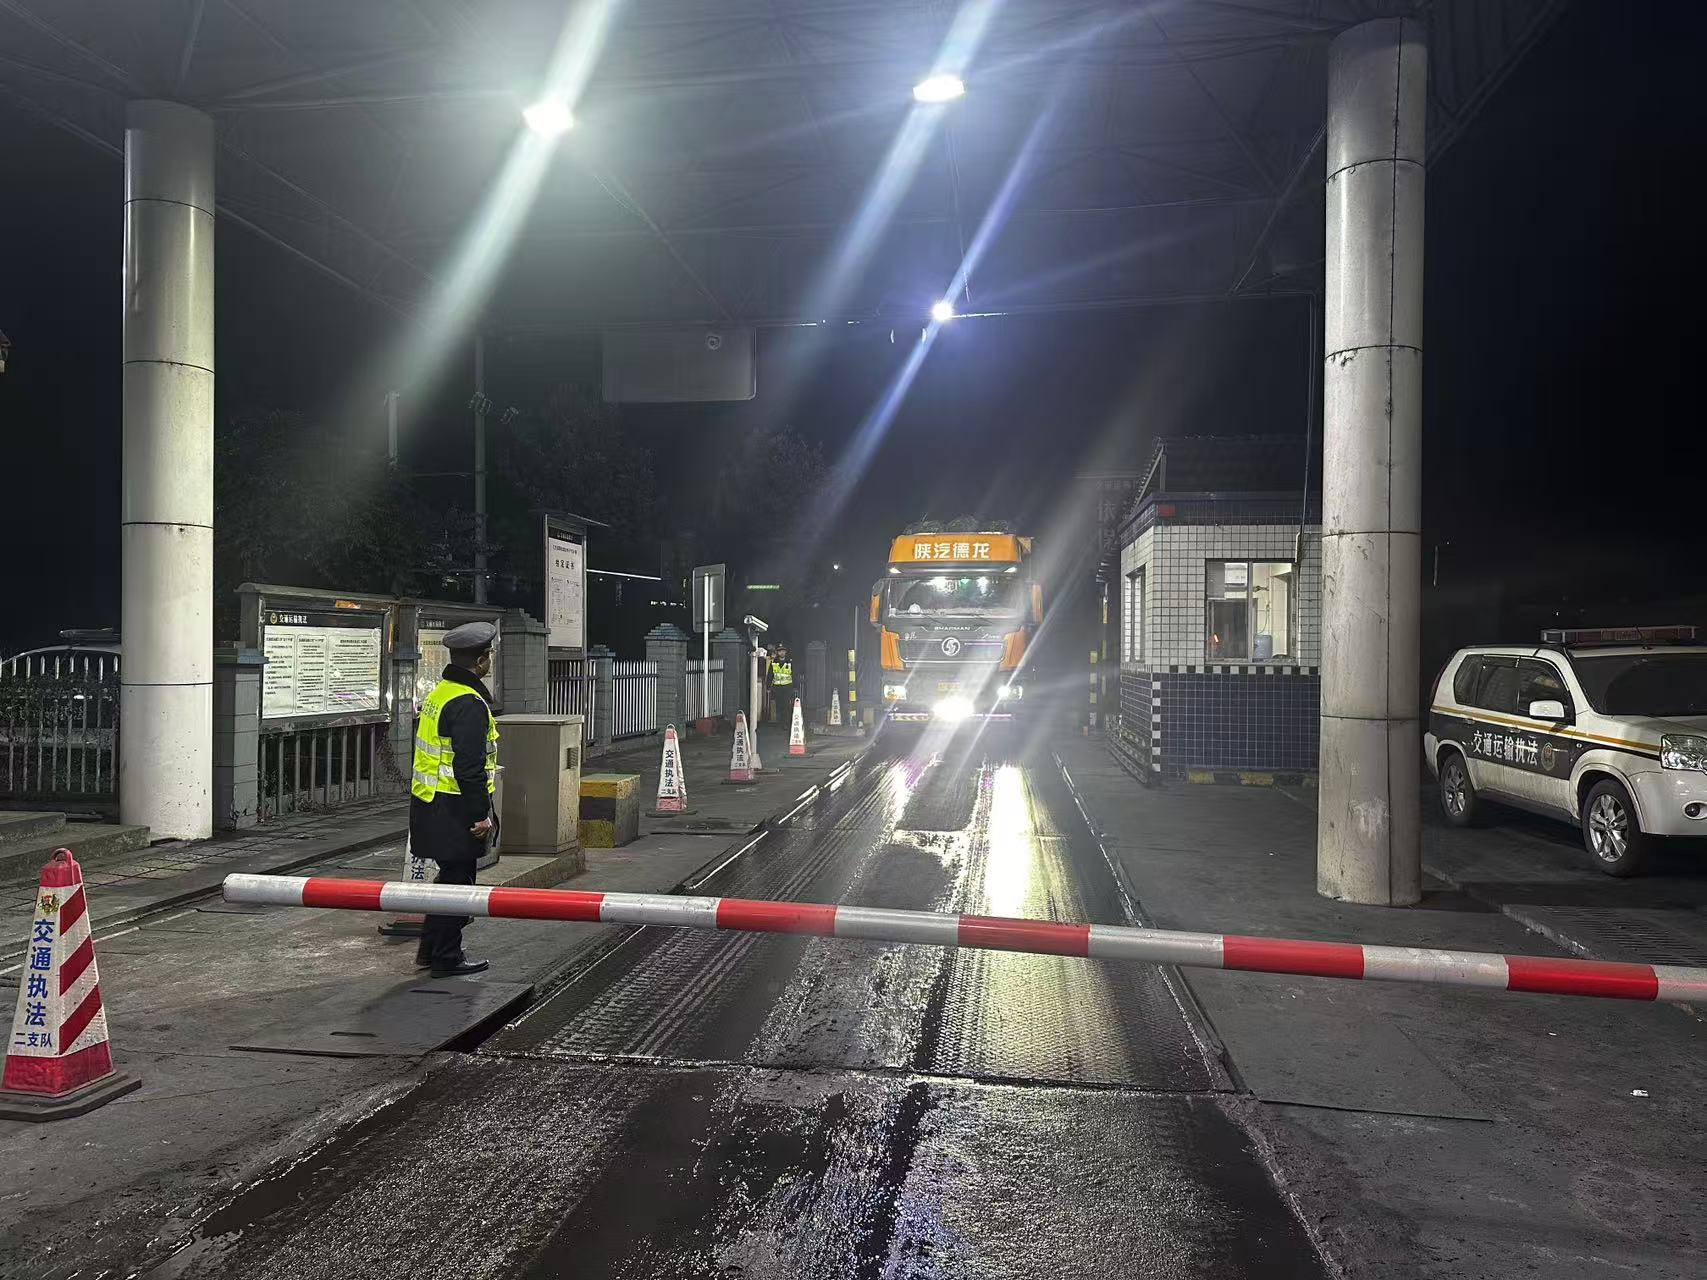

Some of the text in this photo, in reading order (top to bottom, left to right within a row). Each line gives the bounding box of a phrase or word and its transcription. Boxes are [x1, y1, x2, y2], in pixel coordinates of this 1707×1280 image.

[914, 542, 990, 560] 陕汽德龙
[736, 731, 744, 762] 交通执法
[1474, 731, 1538, 763] 交通运输执法
[664, 749, 675, 787] 交通执法
[25, 918, 55, 1027] 交通执法
[14, 1031, 53, 1049] 二支队
